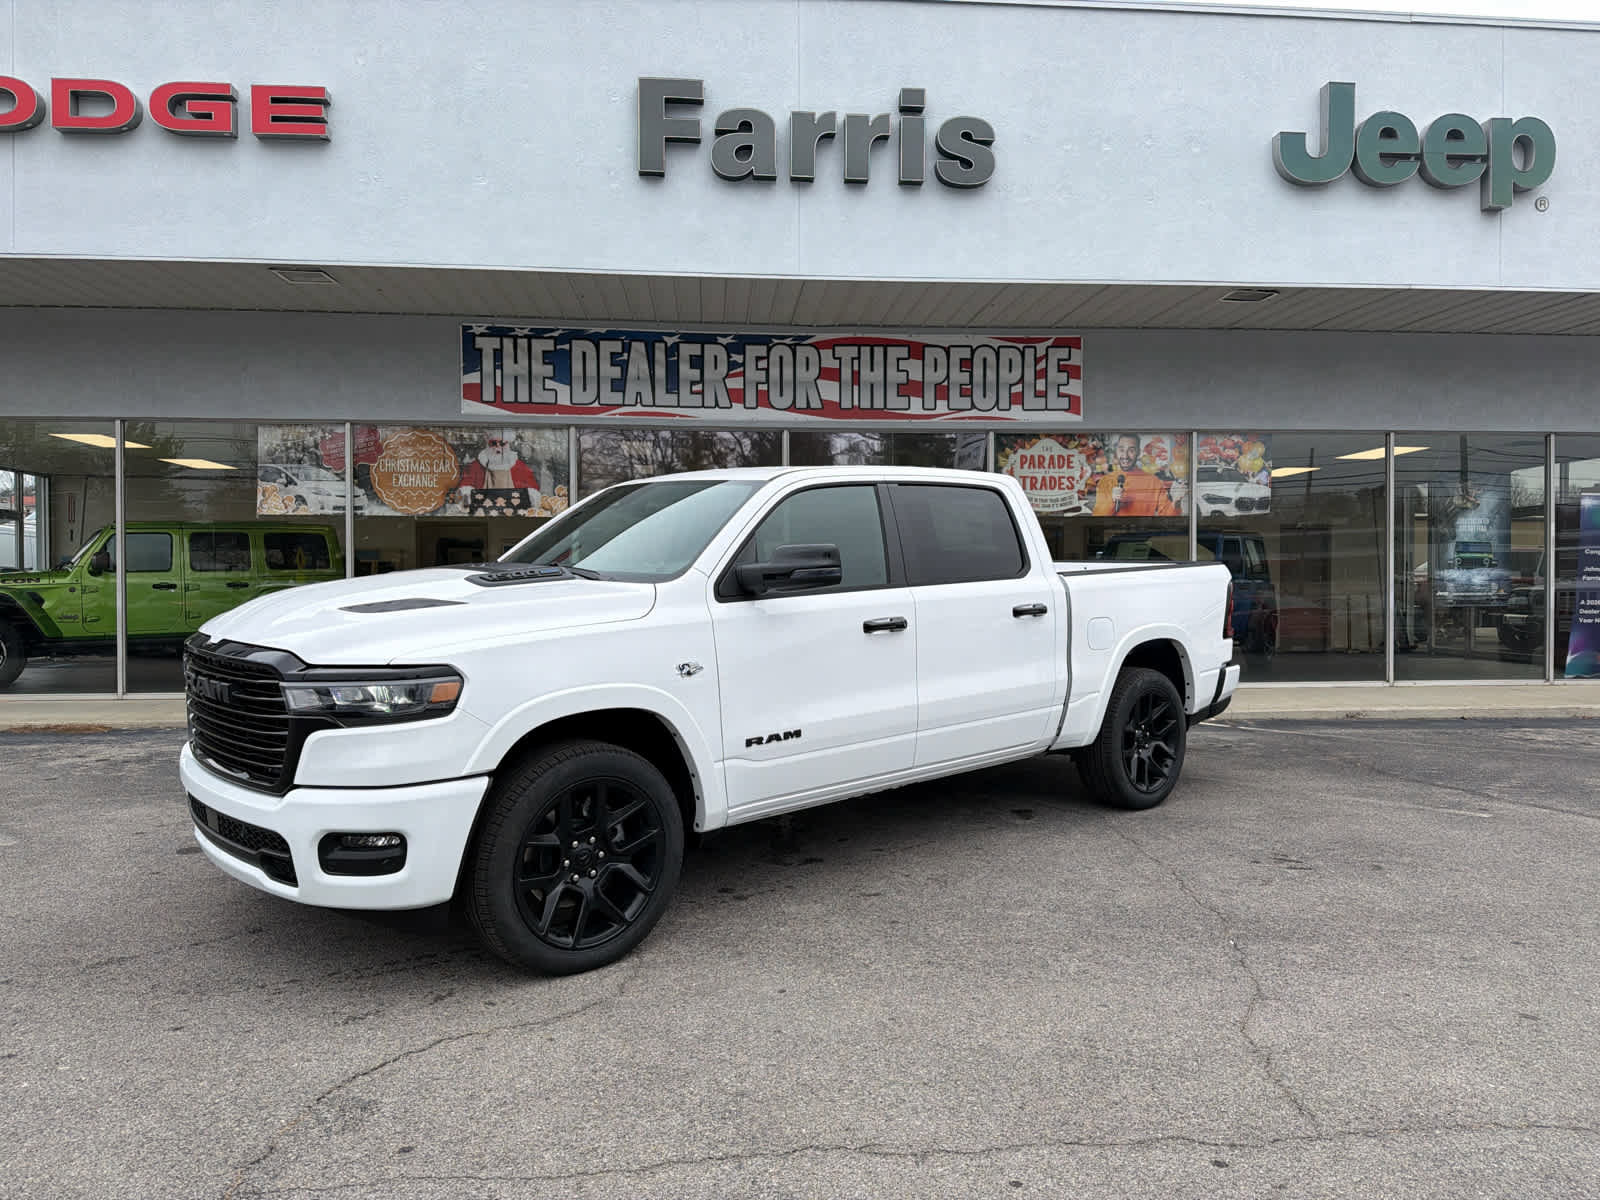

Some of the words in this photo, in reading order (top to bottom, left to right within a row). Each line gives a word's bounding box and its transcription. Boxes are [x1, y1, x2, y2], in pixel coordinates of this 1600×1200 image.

[638, 77, 995, 189] Farris
[1272, 81, 1557, 212] Jeep
[474, 335, 558, 405] THE
[568, 337, 733, 409] DEALER
[744, 341, 824, 412] FOR
[832, 344, 911, 411] THE
[922, 344, 1072, 412] PEOPLE
[379, 458, 431, 473] CHRISTMAS
[433, 458, 452, 473] CAR
[1019, 454, 1075, 470] PARADE
[392, 473, 440, 488] EXCHANGE
[1019, 475, 1075, 491] TRADES
[745, 728, 802, 748] RAM
